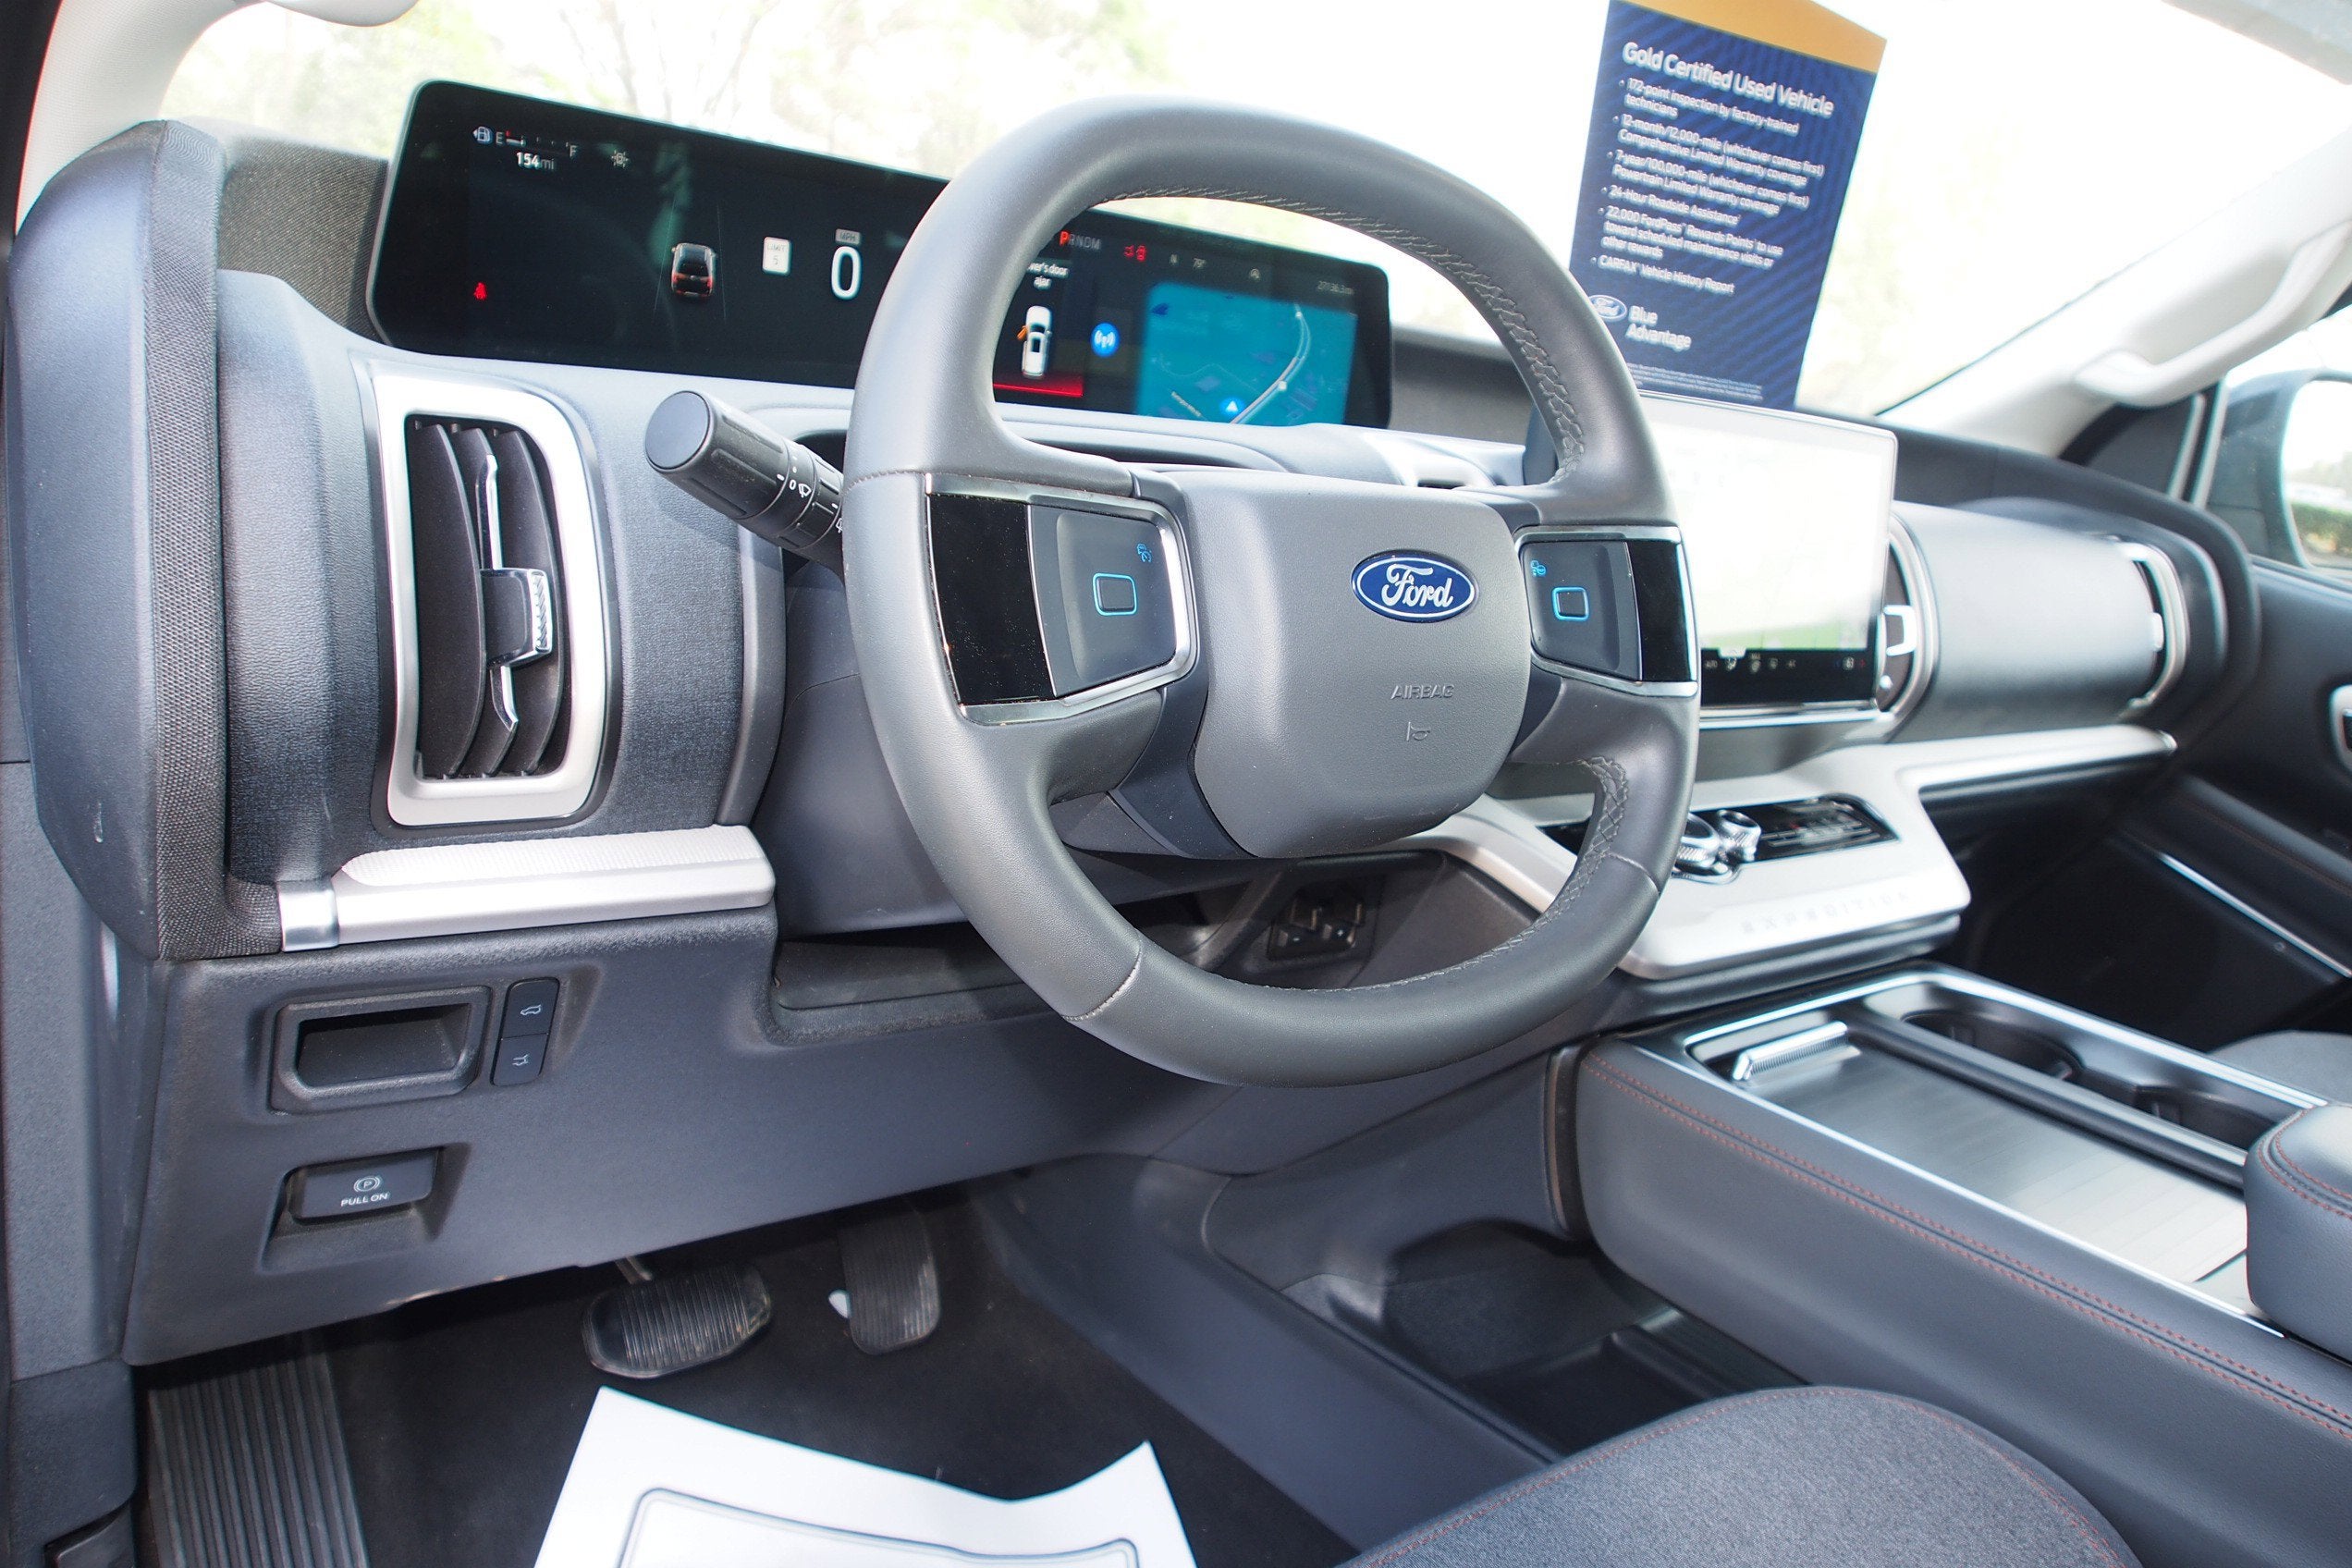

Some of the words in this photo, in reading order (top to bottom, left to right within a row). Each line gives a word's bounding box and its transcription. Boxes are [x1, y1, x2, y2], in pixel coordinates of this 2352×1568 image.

[1622, 40, 1663, 71] Gold
[1663, 52, 1733, 90] Certified
[1733, 71, 1777, 102] Used
[1774, 82, 1835, 117] Vehicle
[1623, 92, 1678, 118] technicians
[1626, 77, 1670, 103] 172-point
[1670, 89, 1719, 116] inspection
[1718, 103, 1730, 119] by
[1730, 105, 1799, 137] factory-trained
[496, 131, 504, 144] E
[570, 145, 577, 158] F
[1617, 127, 1691, 158] Comprehensive
[1690, 147, 1724, 166] Limited
[1723, 155, 1767, 178] Warranty
[1770, 153, 1803, 172] comes
[1801, 160, 1825, 178] first)
[1609, 184, 1648, 204] 24-Hour
[1648, 193, 1690, 214] Roadside
[1611, 163, 1664, 188] Powertrain
[1663, 177, 1698, 196] Limited
[1697, 185, 1739, 207] Warranty
[1756, 186, 1788, 202] comes
[1786, 191, 1810, 209] first)
[1600, 233, 1627, 251] other
[1626, 239, 1664, 259] rewards
[1602, 219, 1638, 239] toward
[1636, 227, 1684, 249] scheduled
[1683, 238, 1741, 261] maintenance
[1739, 251, 1763, 266] visits
[1762, 257, 1774, 268] or
[1685, 224, 1727, 244] Rewards
[1756, 239, 1767, 252] to
[1765, 244, 1784, 257] use
[831, 245, 861, 300] 0
[1639, 263, 1673, 280] Vehicle
[1672, 270, 1705, 288] History
[1704, 277, 1735, 294] Report
[1629, 305, 1658, 325] Blue
[1625, 324, 1692, 351] Advantage
[1380, 563, 1454, 608] Ford
[1390, 684, 1455, 701] AIRBAG
[340, 1195, 368, 1207] PULL
[371, 1192, 388, 1202] ON
